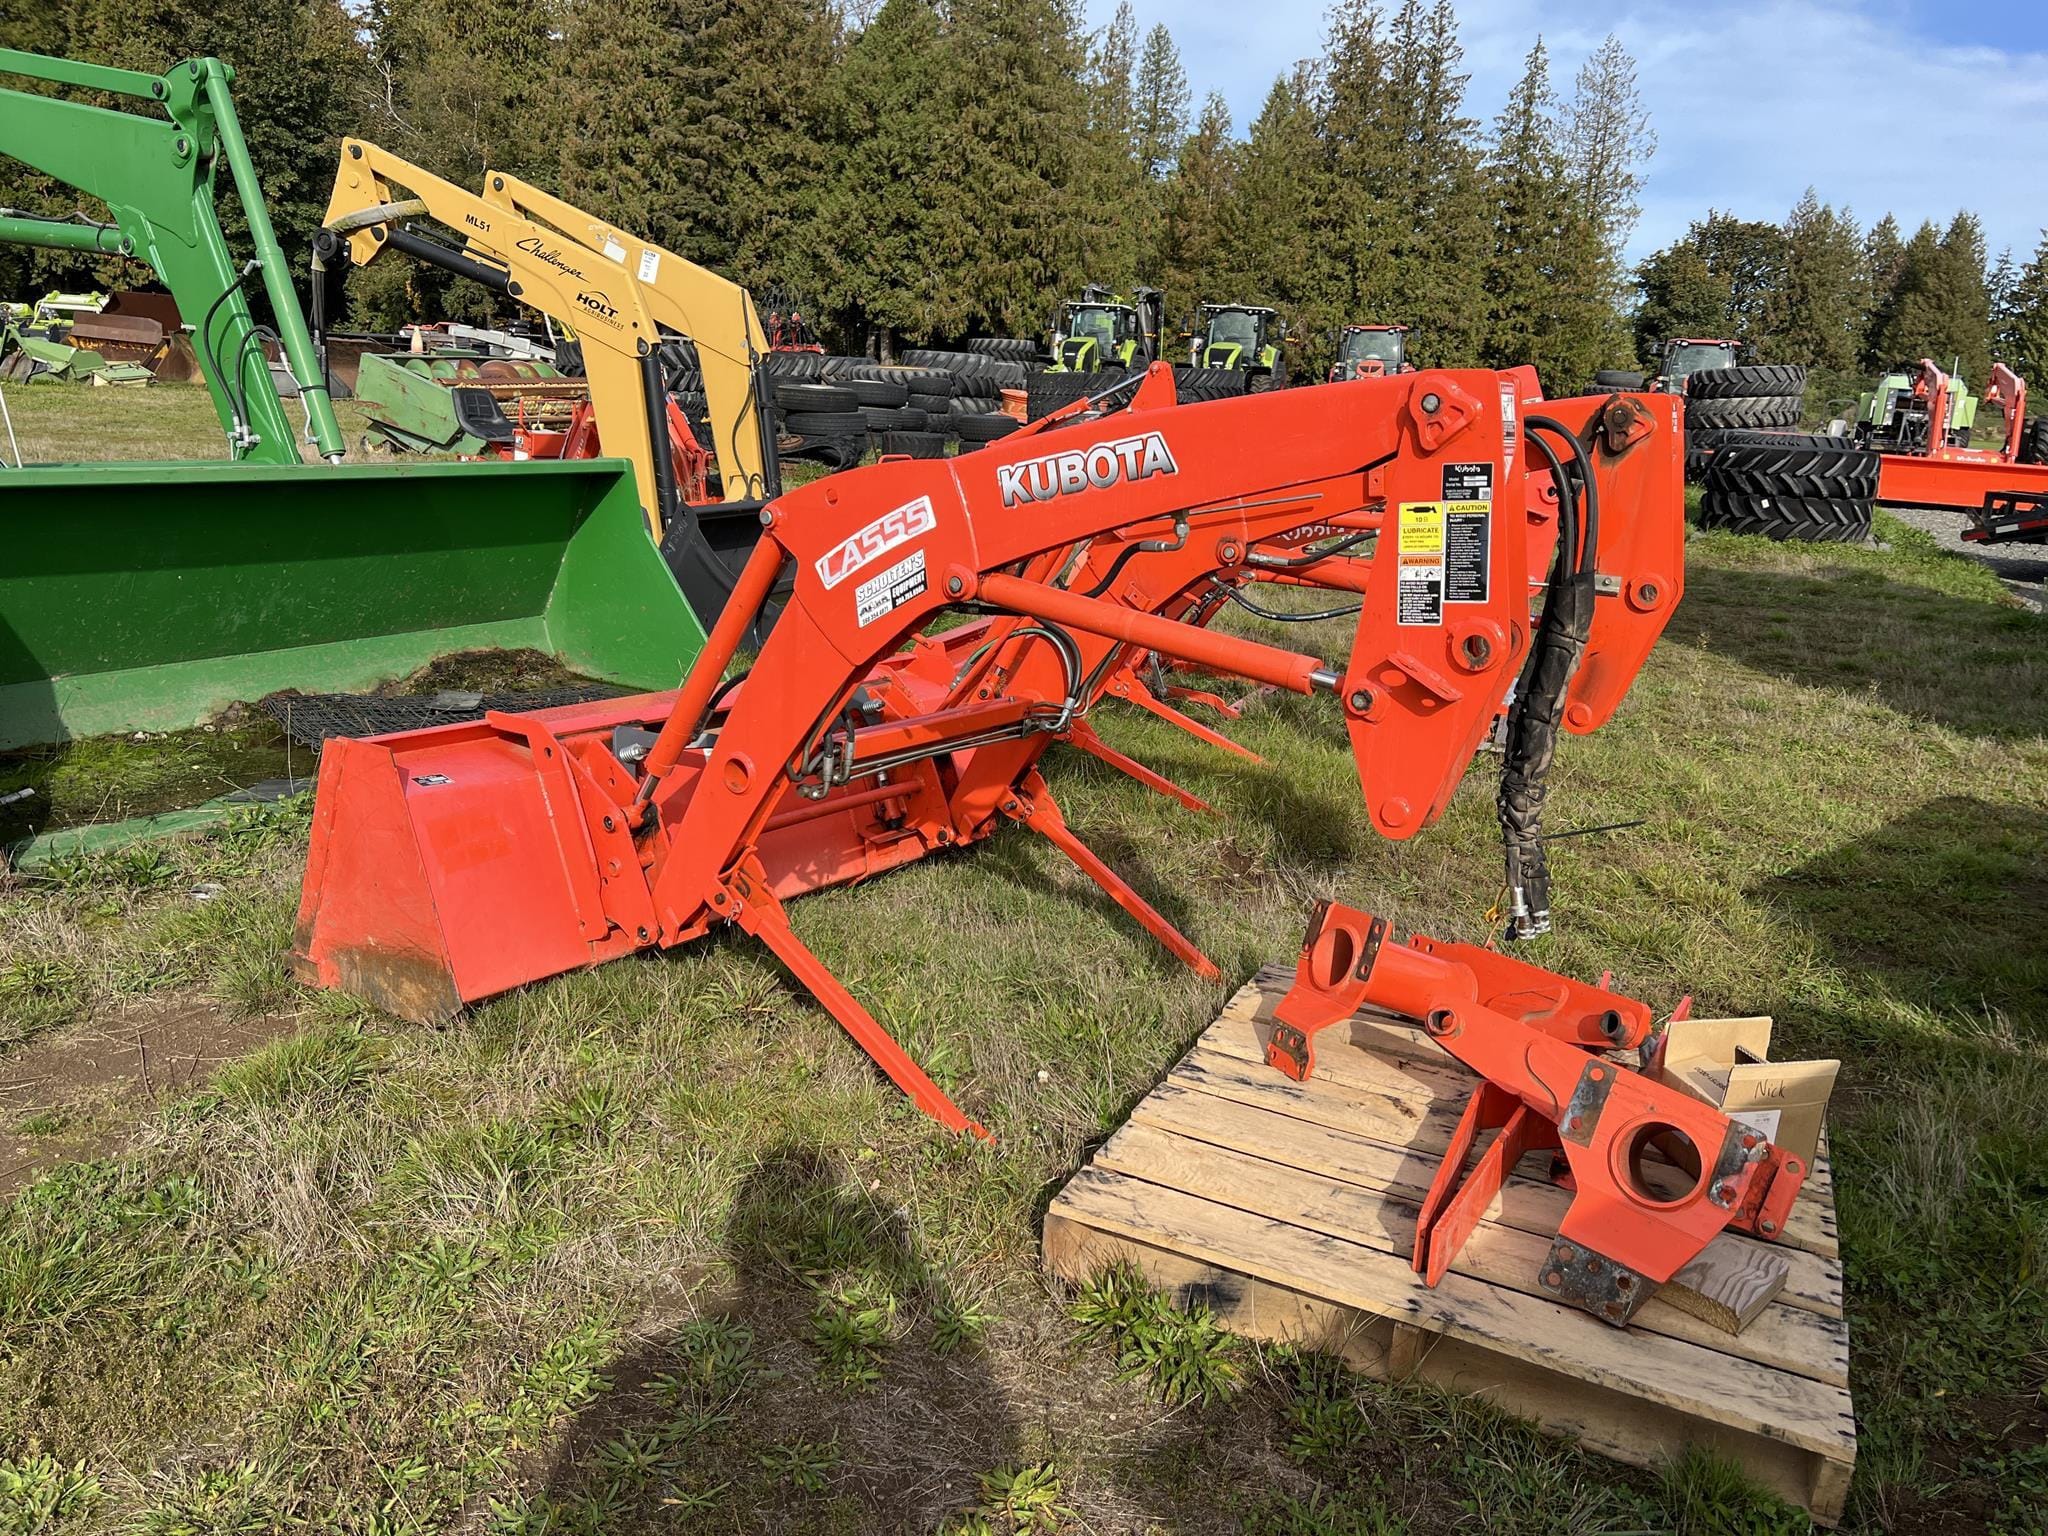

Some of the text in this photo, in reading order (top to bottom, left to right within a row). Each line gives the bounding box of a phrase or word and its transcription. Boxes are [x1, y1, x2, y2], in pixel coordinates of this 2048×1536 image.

[465, 213, 491, 233] ML51
[516, 238, 591, 284] Challenger
[576, 292, 619, 318] HOLT
[583, 306, 625, 330] AGRIBUSINESS
[999, 434, 1177, 507] KUBOTA
[821, 500, 929, 585] LA555
[857, 551, 924, 603] SCHOLTEN'S
[892, 570, 925, 598] EQUIPMENT
[1754, 1079, 1786, 1100] Nick
